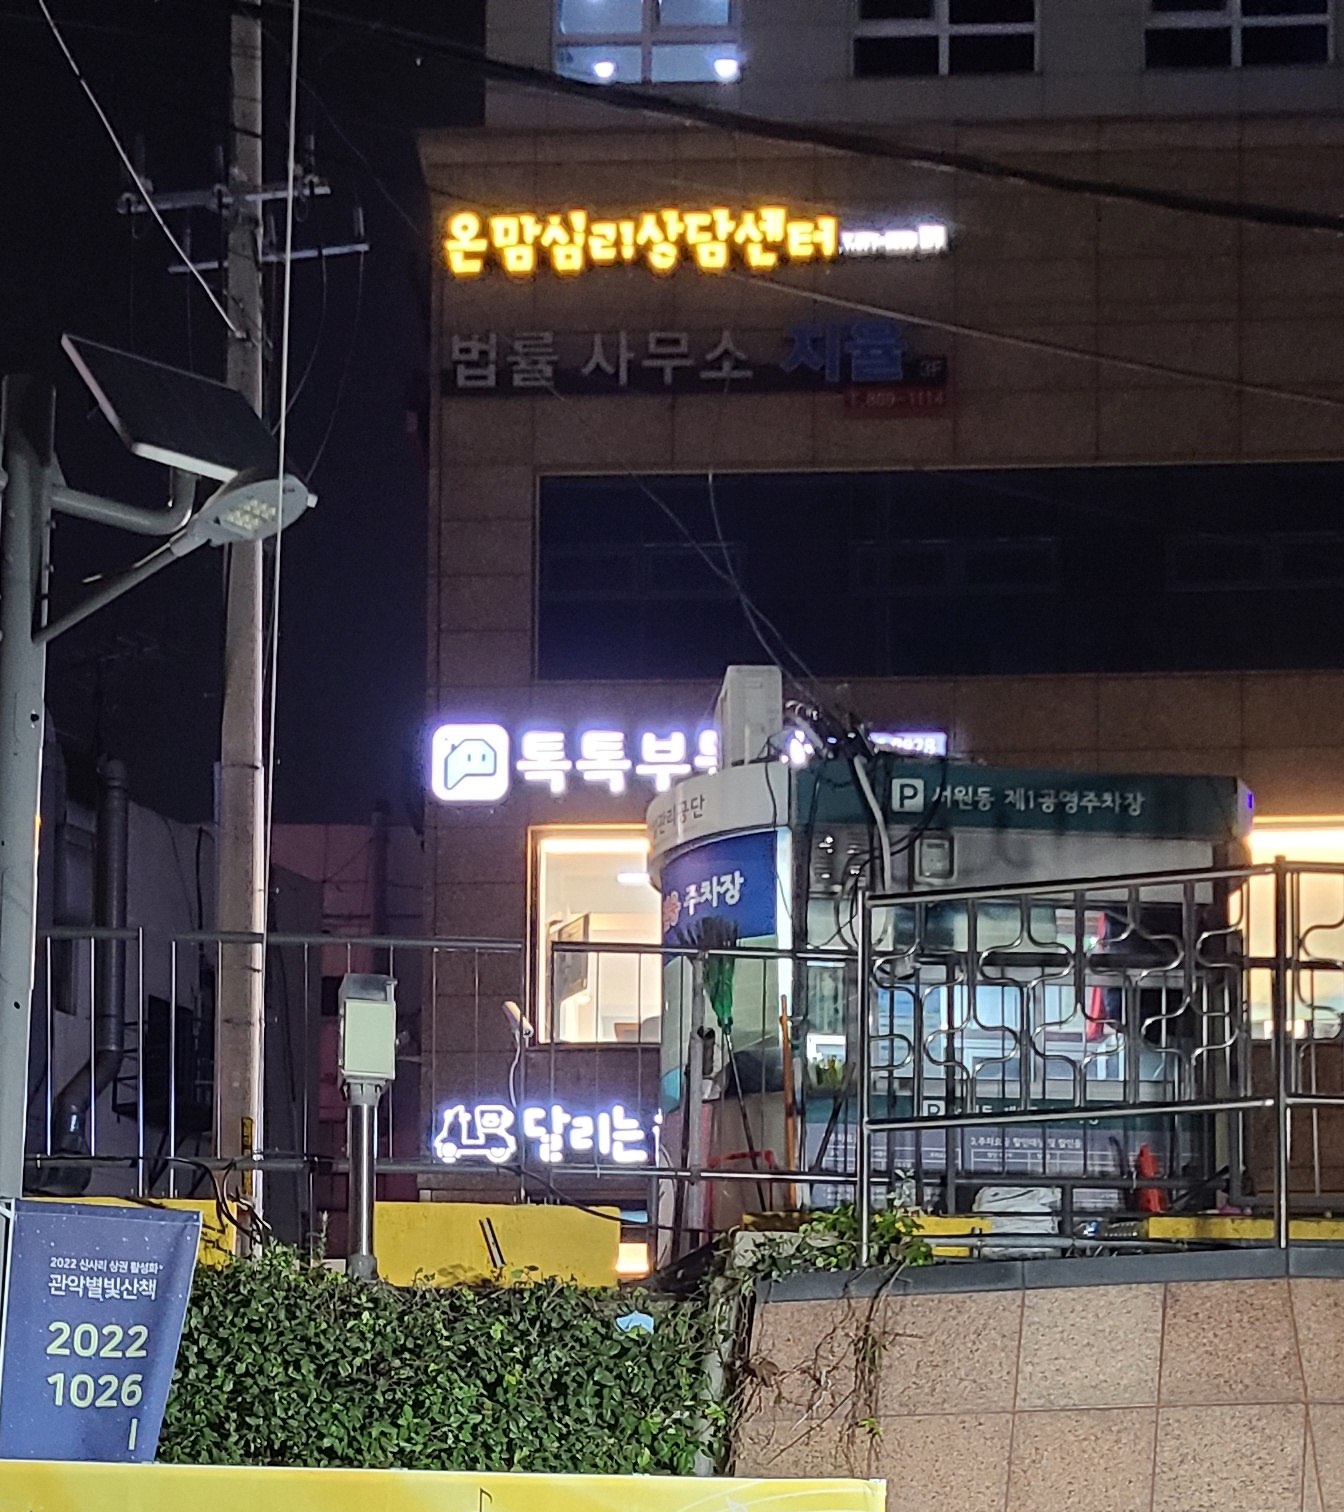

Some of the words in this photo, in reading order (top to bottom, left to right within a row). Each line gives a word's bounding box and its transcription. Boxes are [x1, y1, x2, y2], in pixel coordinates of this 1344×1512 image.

[444, 206, 839, 277] 온맘심리상담센터
[452, 331, 558, 388] 법률
[582, 329, 753, 386] 사무소
[931, 785, 996, 811] 서원동
[1004, 788, 1145, 817] 제1공영주차장
[684, 870, 745, 916] 주차장
[523, 1105, 649, 1163] 달리는
[50, 1257, 76, 1269] 2022
[79, 1258, 107, 1271] 신사리
[109, 1259, 128, 1272] 상권
[48, 1274, 157, 1301] 관악별빛산책
[46, 1321, 149, 1359] 2022
[46, 1373, 143, 1409] 1026
